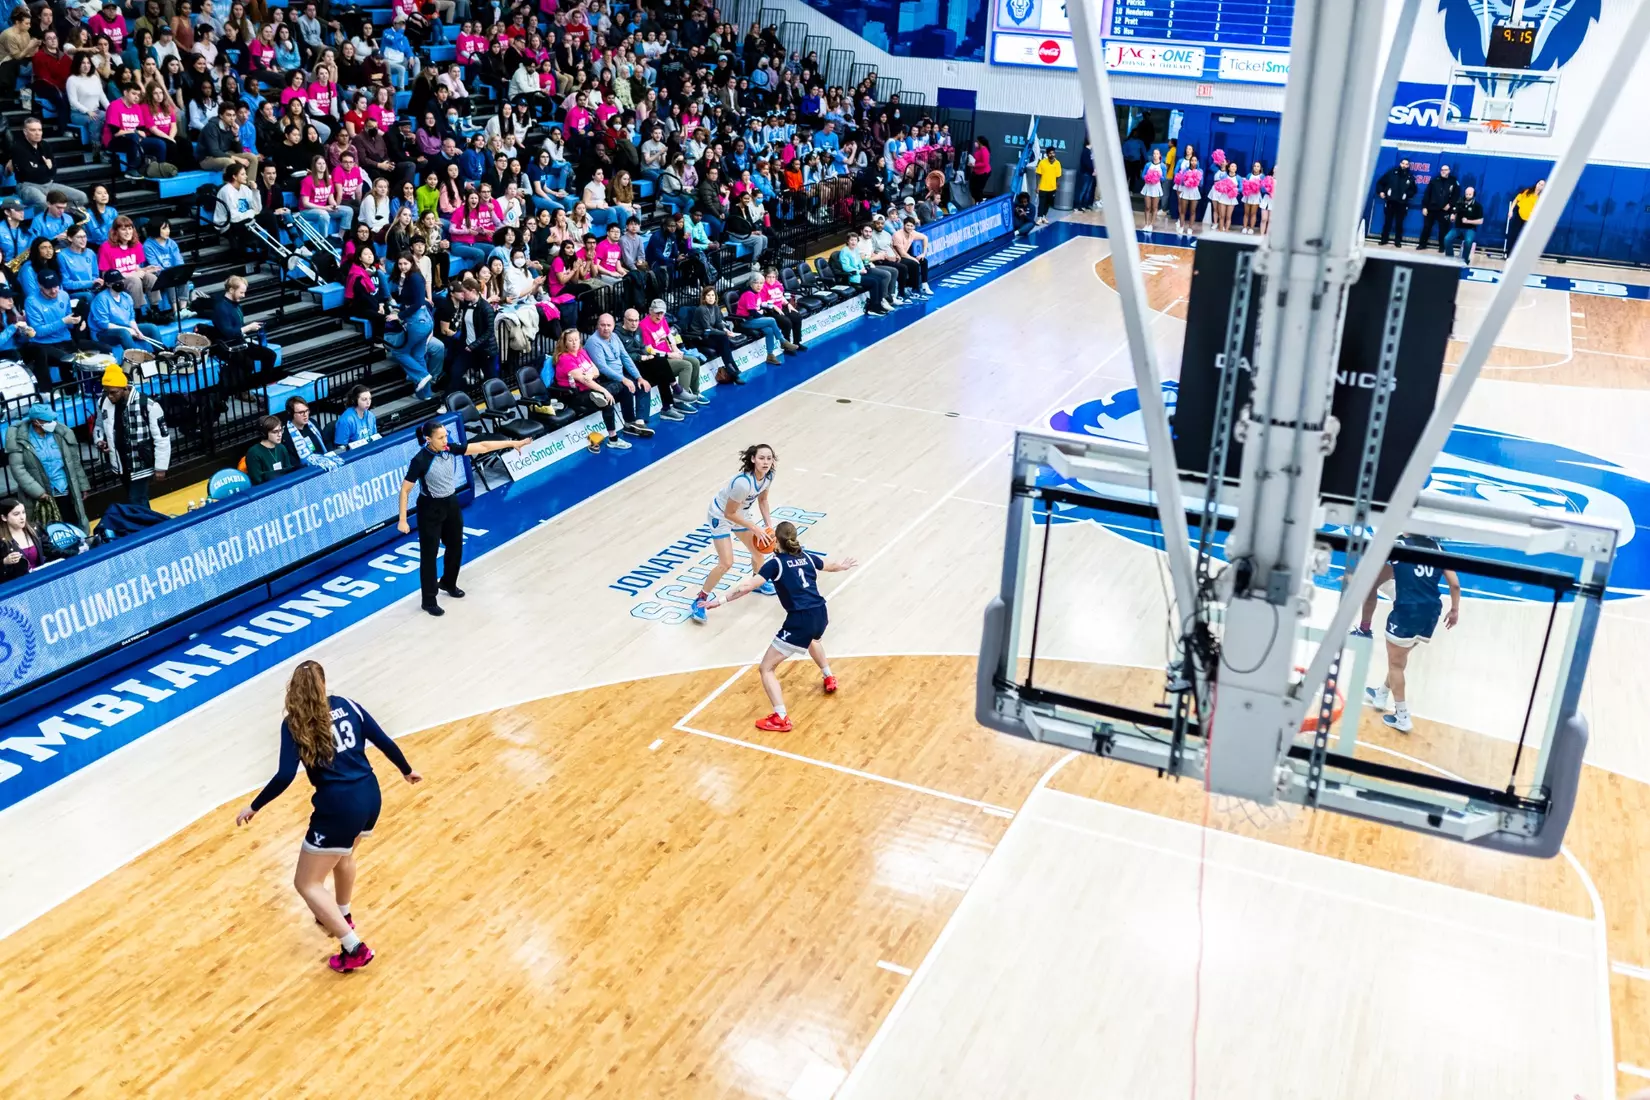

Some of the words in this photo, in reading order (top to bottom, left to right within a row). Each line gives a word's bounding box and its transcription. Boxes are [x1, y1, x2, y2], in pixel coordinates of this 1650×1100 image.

[1197, 84, 1213, 96] EXIT
[1004, 135, 1066, 149] COLBIA
[508, 439, 566, 472] TicketSmarter
[213, 474, 246, 490] COLUMBIA
[40, 534, 246, 645] COLUMBIA-BARNARD
[248, 504, 323, 556] ATHLETIC
[322, 465, 408, 523] CONSORTIU
[787, 558, 809, 568] CLARK
[798, 567, 810, 588] 1
[780, 629, 792, 641] Y
[1388, 622, 1399, 634] Y
[329, 719, 357, 754] 13
[313, 831, 326, 846] Y
